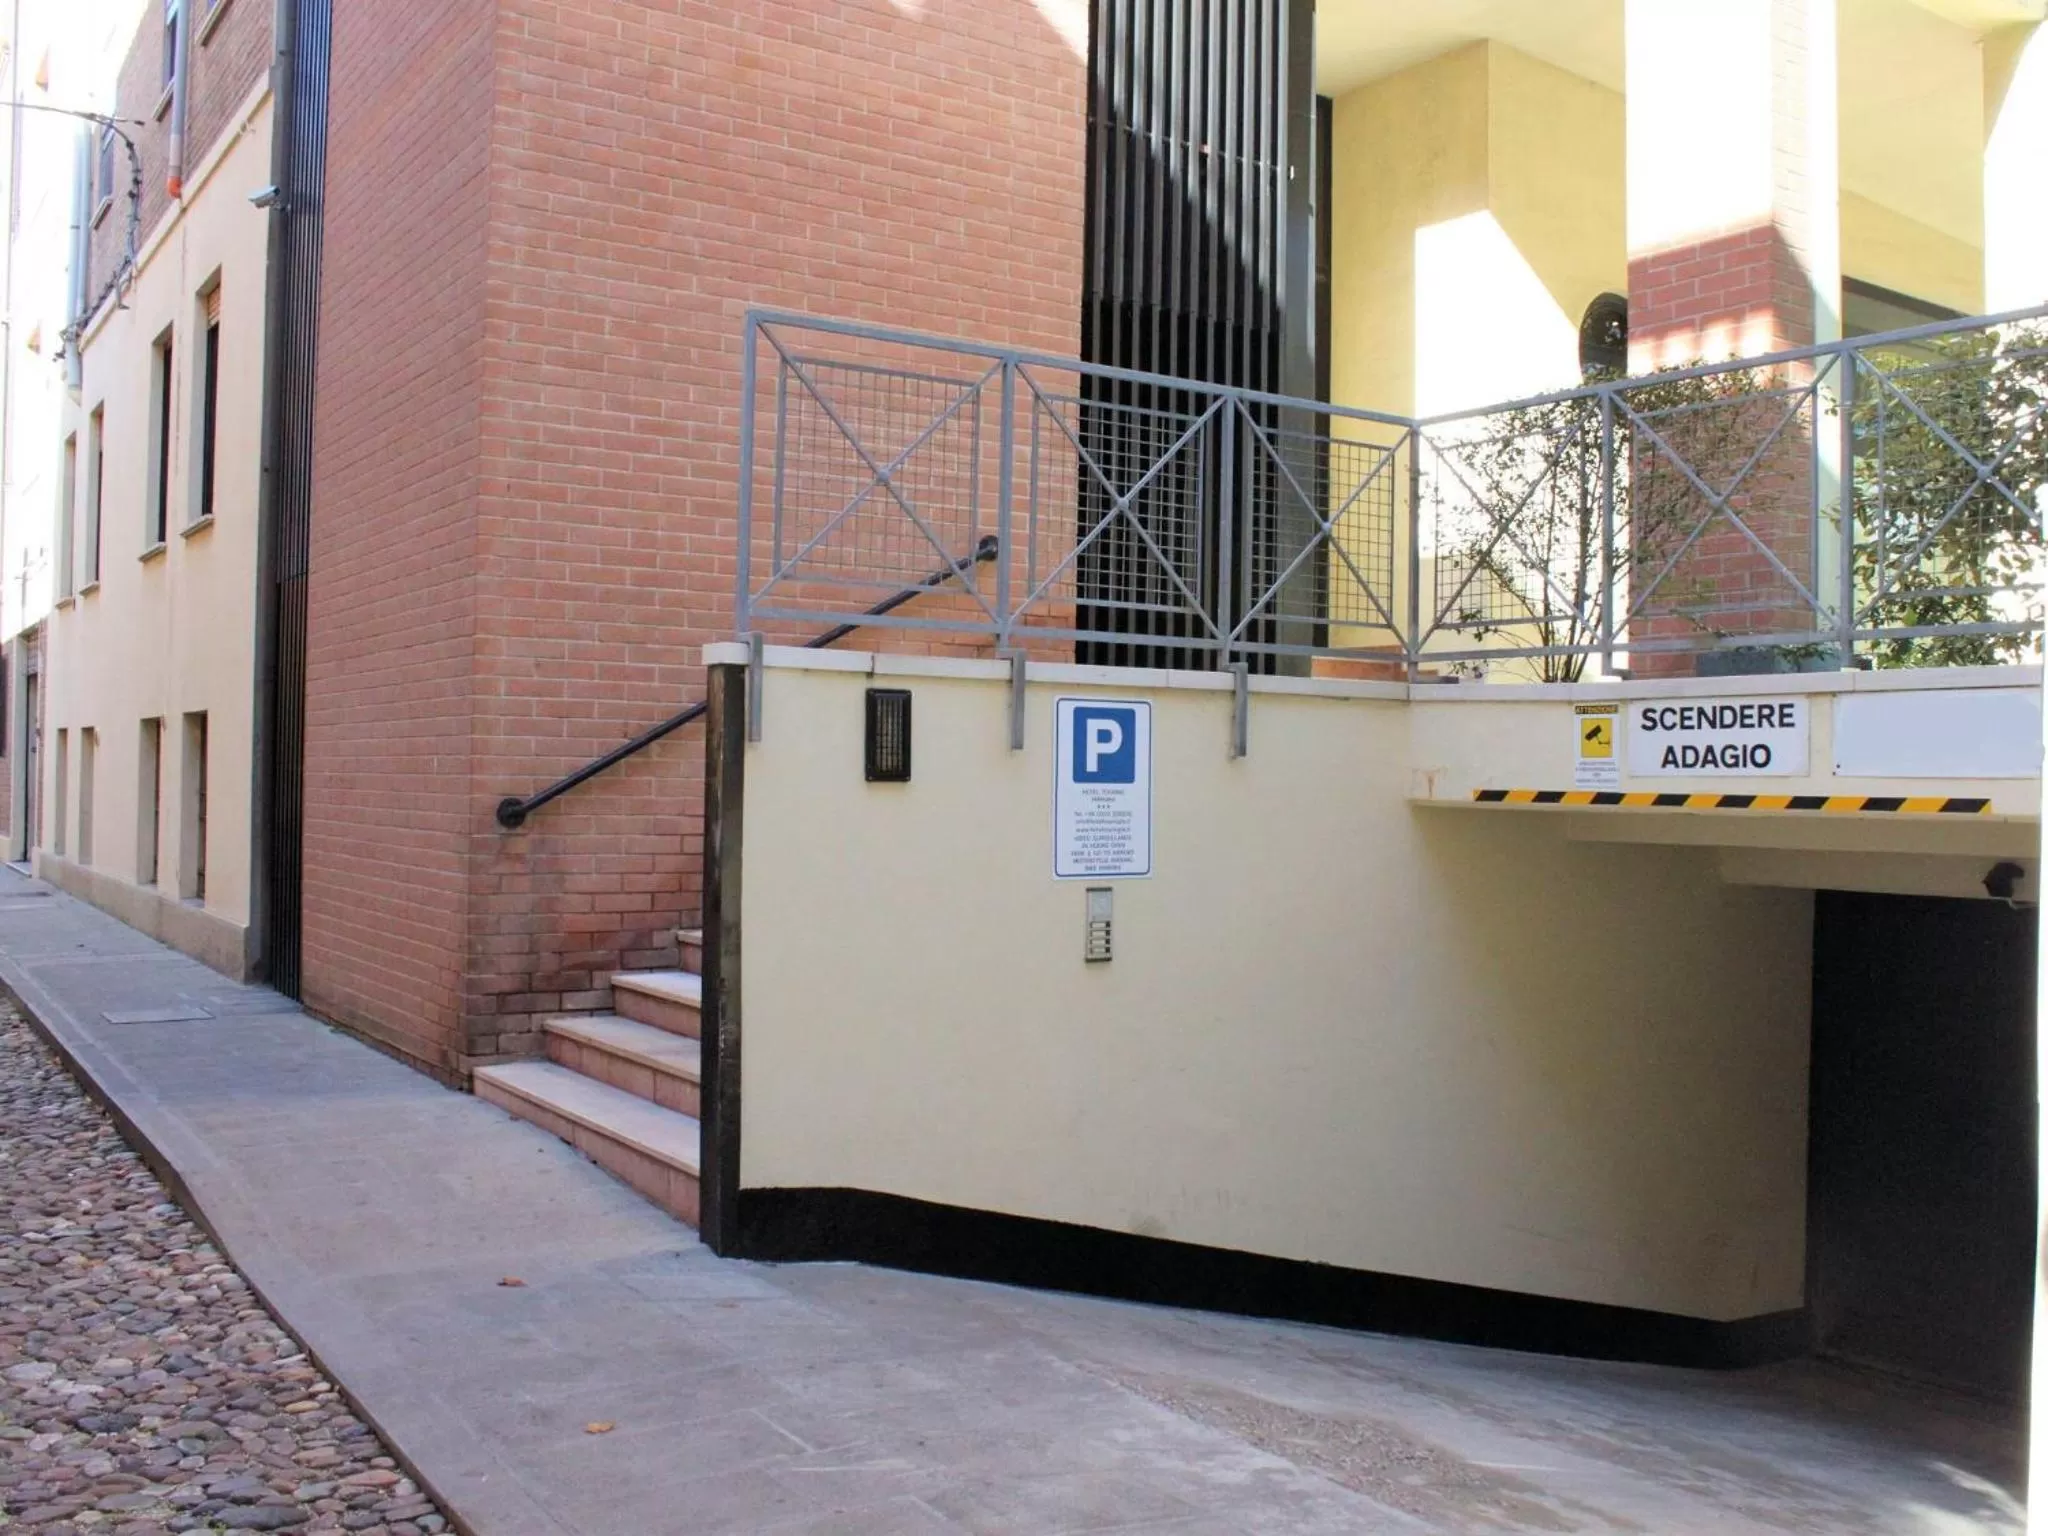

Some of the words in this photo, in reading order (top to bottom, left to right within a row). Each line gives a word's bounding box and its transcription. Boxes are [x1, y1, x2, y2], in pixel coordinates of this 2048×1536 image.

[1641, 703, 1795, 731] SCENDERE
[1086, 718, 1123, 773] P
[1661, 743, 1772, 769] ADAGIO
